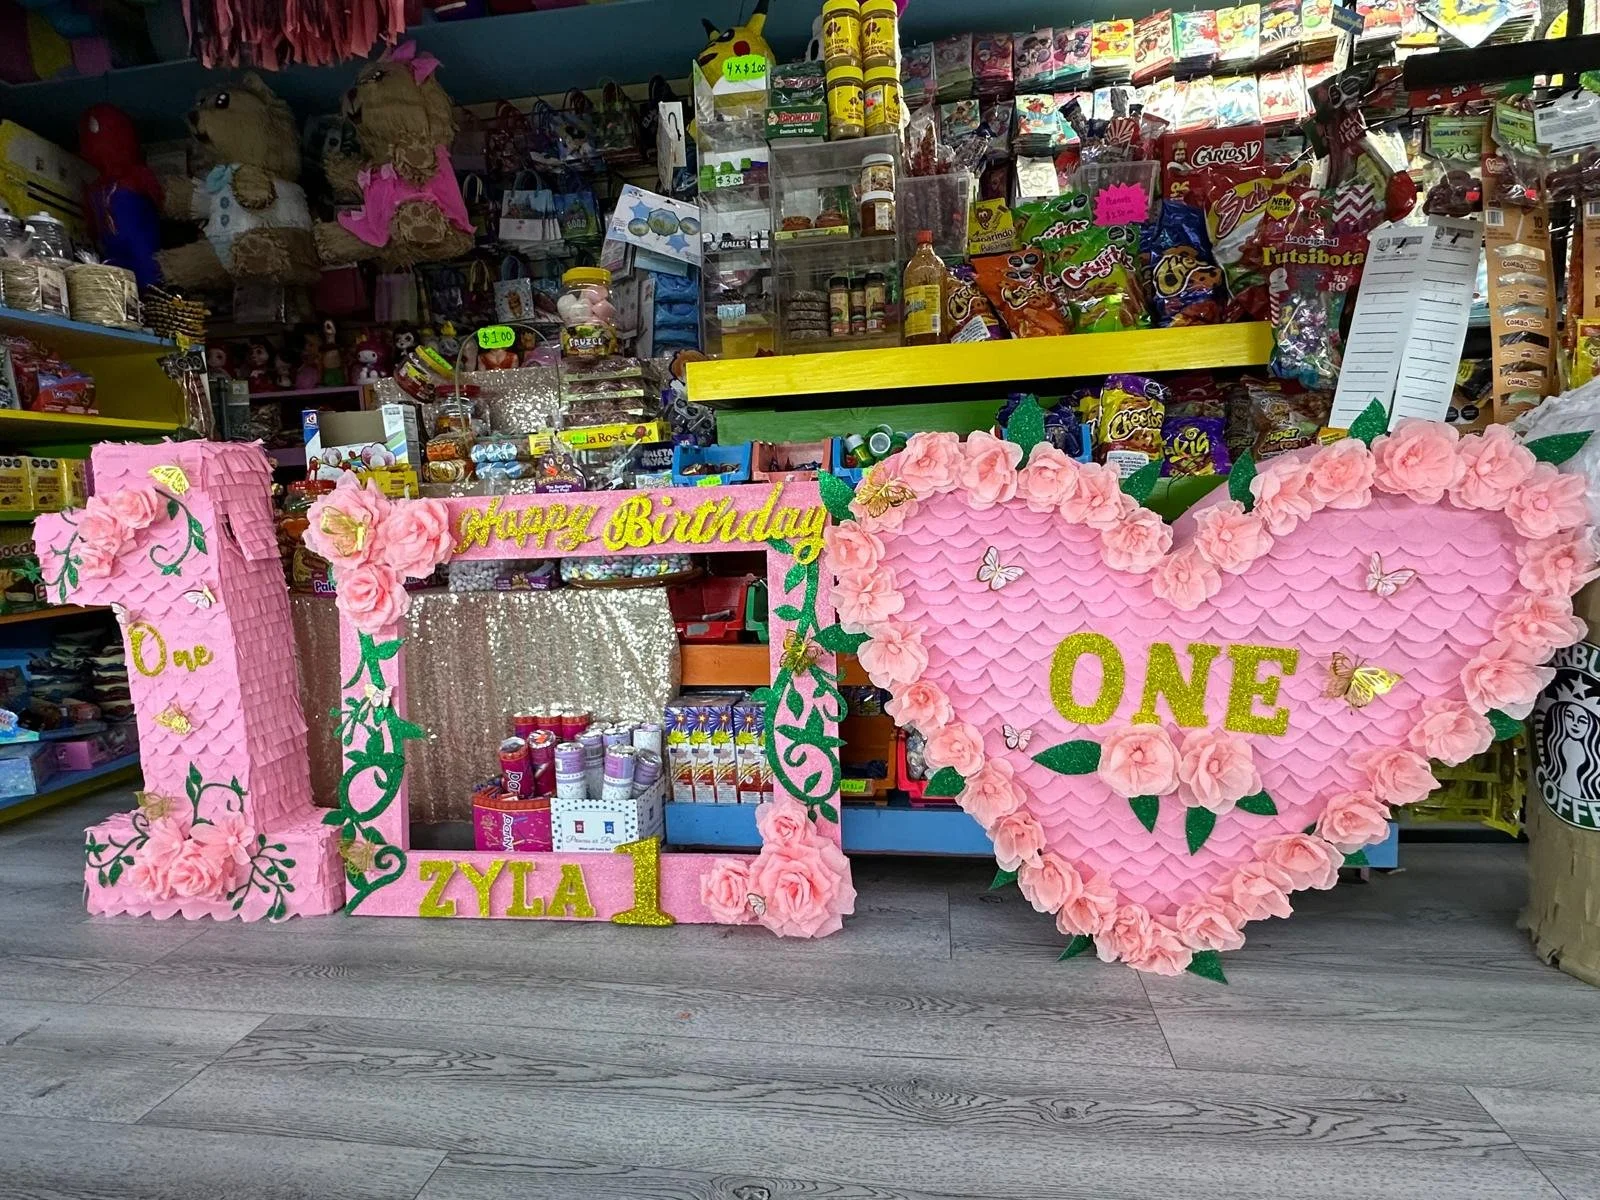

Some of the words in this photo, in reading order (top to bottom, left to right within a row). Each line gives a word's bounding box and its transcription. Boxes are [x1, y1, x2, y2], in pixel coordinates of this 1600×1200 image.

[727, 62, 733, 76] 4
[1191, 145, 1248, 168] CARLOS
[1243, 140, 1261, 163] V
[1273, 197, 1291, 205] NEW
[720, 240, 746, 248] HALLS
[599, 430, 627, 444] Rosa
[1108, 409, 1164, 441] Cheetos
[452, 496, 598, 554] Happy
[603, 481, 827, 565] Birthday
[127, 622, 214, 676] One
[1049, 632, 1299, 737] ONE
[418, 860, 597, 918] ZYLA
[611, 836, 676, 926] 1
